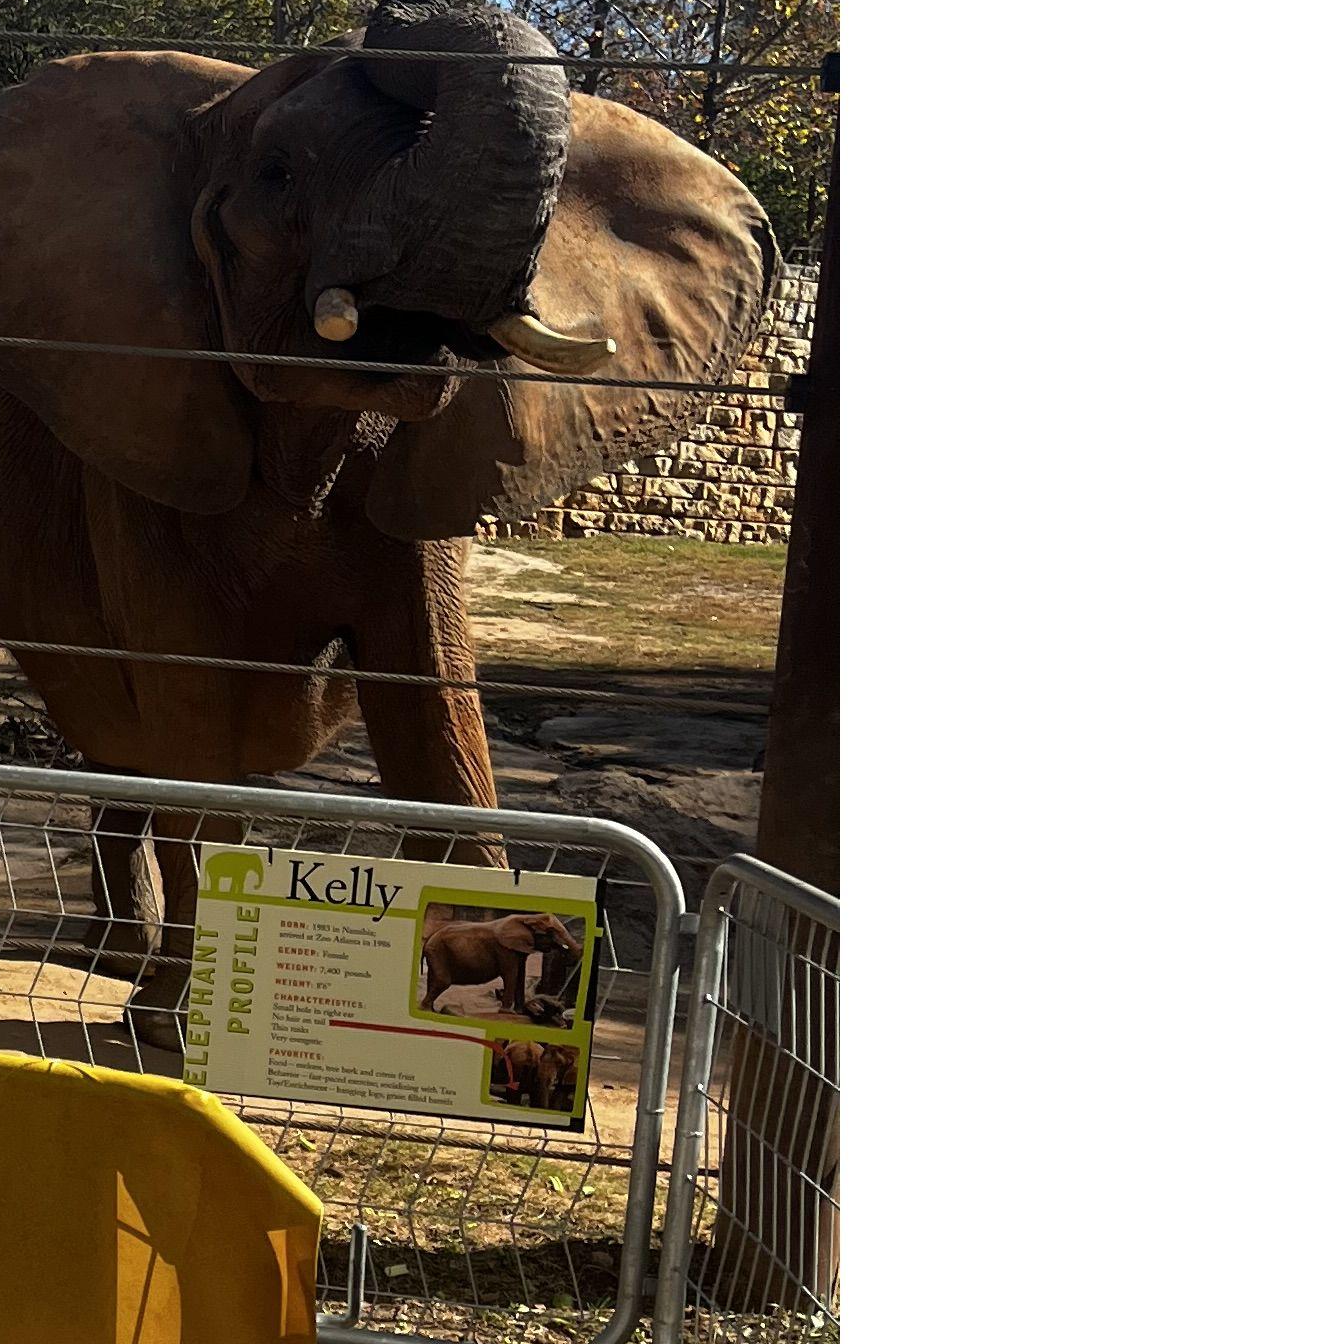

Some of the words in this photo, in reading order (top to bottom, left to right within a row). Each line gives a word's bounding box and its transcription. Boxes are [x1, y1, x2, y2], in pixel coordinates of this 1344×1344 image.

[286, 860, 403, 922] Kelly
[280, 920, 310, 929] BORN:
[315, 934, 332, 942] Zoo
[278, 946, 319, 957] GENDER:
[228, 906, 260, 1034] PROFILE
[277, 962, 317, 972] WEIGHT:
[275, 978, 313, 988] HEIGHT:
[184, 924, 218, 1086] ELEPHANT
[274, 992, 366, 1009] CHARACTERISTICS:
[269, 1048, 324, 1060] FAVORITES:
